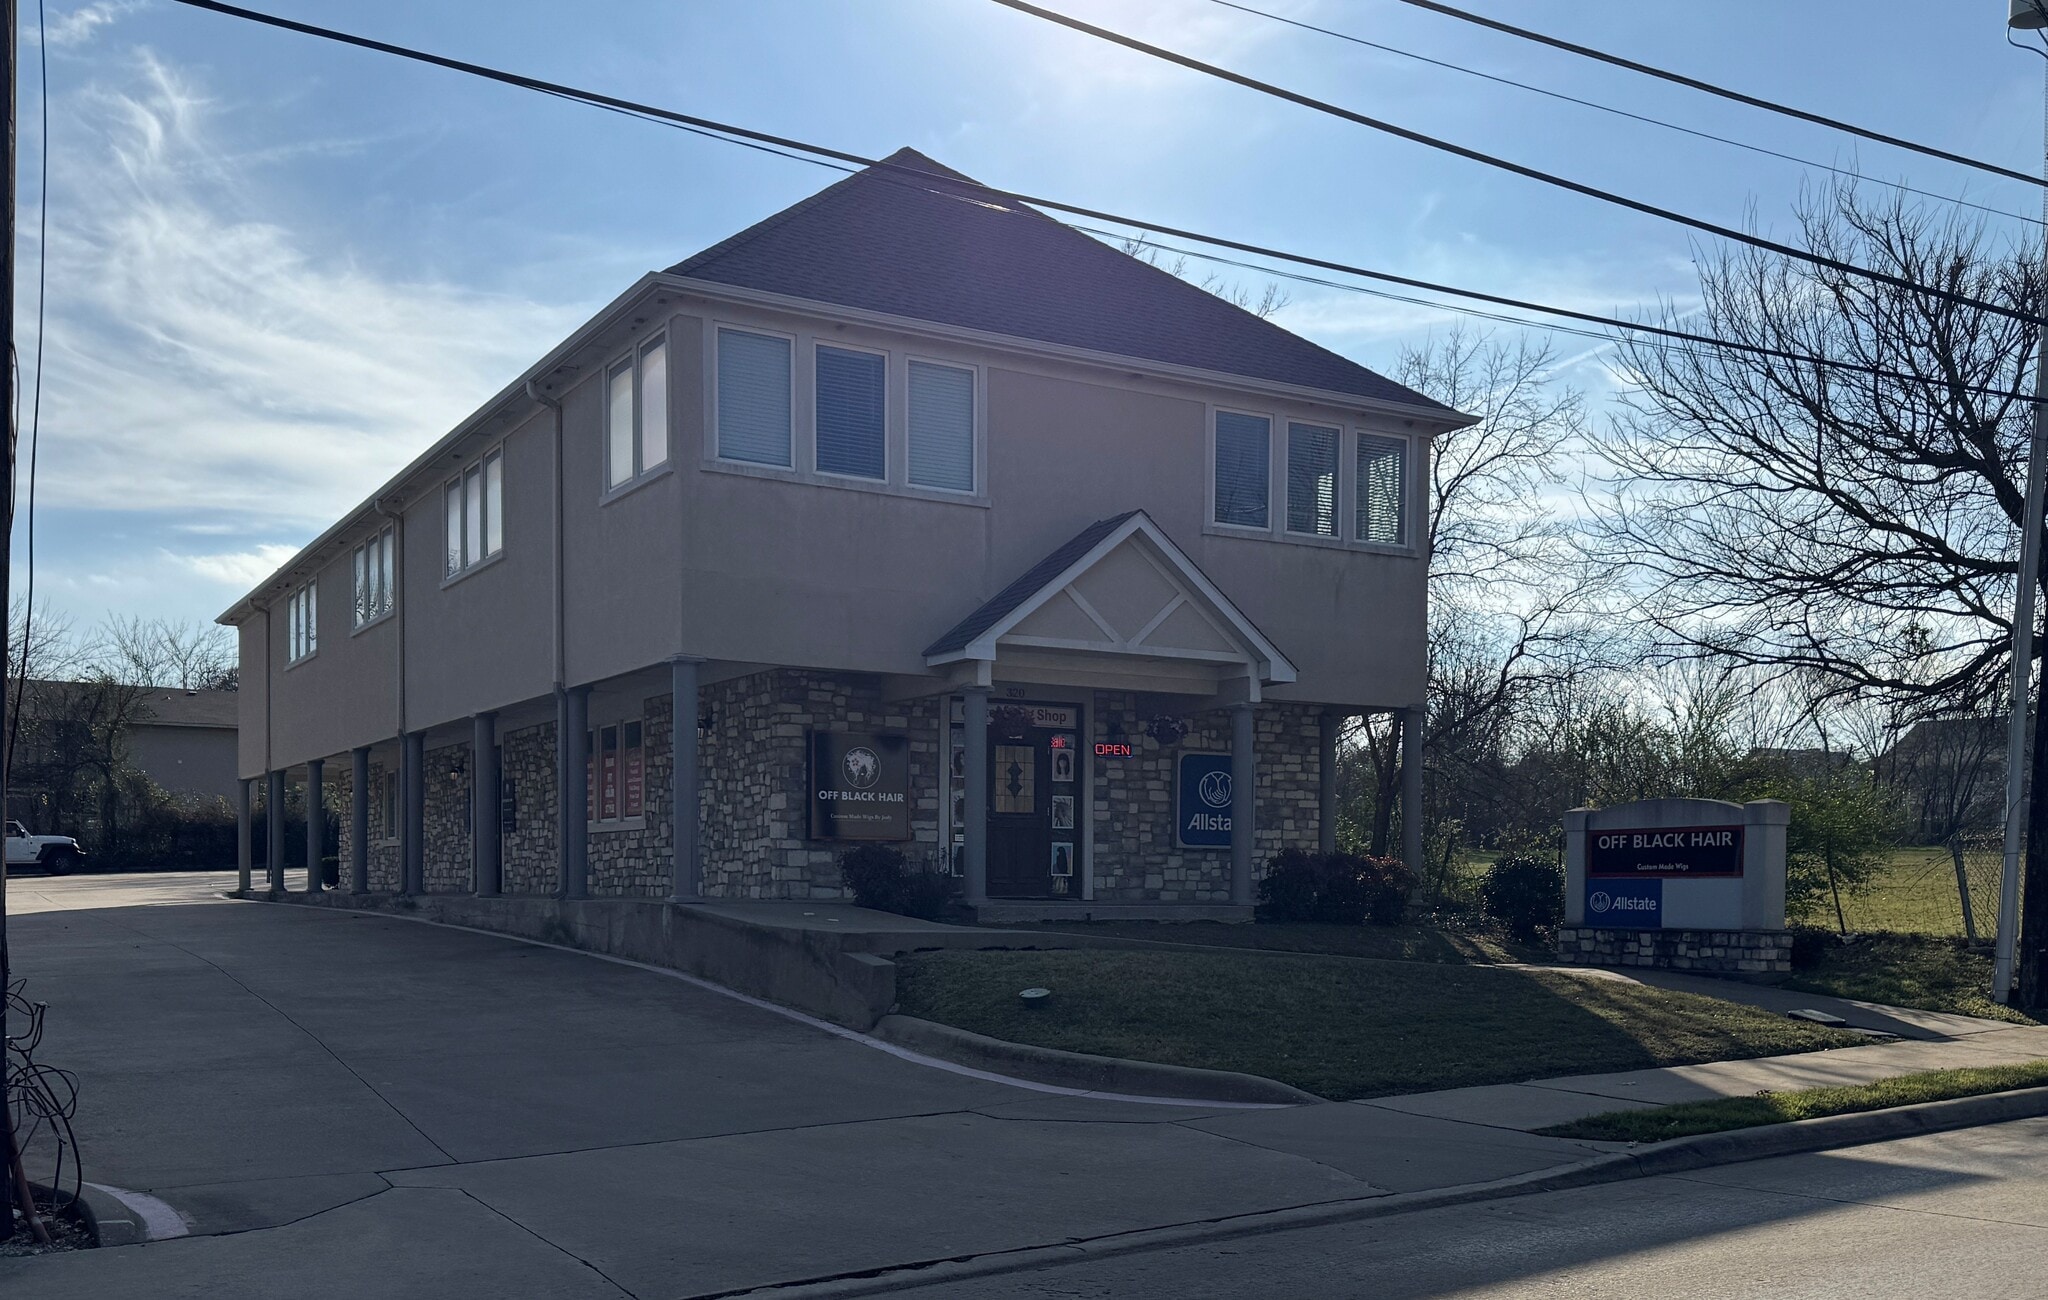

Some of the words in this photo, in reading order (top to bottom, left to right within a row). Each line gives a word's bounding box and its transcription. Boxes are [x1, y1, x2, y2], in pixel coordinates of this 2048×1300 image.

[1006, 688, 1024, 697] 320
[1037, 709, 1067, 724] Shop
[1095, 743, 1130, 755] OPEN
[818, 790, 839, 800] OFF
[841, 791, 875, 801] BLACK
[878, 792, 904, 802] HAIR
[1187, 813, 1232, 831] Allsta
[1598, 835, 1627, 850] OFF
[1633, 833, 1685, 849] BLACK
[1691, 831, 1733, 847] HAIR
[1675, 862, 1689, 871] Wigs
[1612, 896, 1656, 911] Allstate
